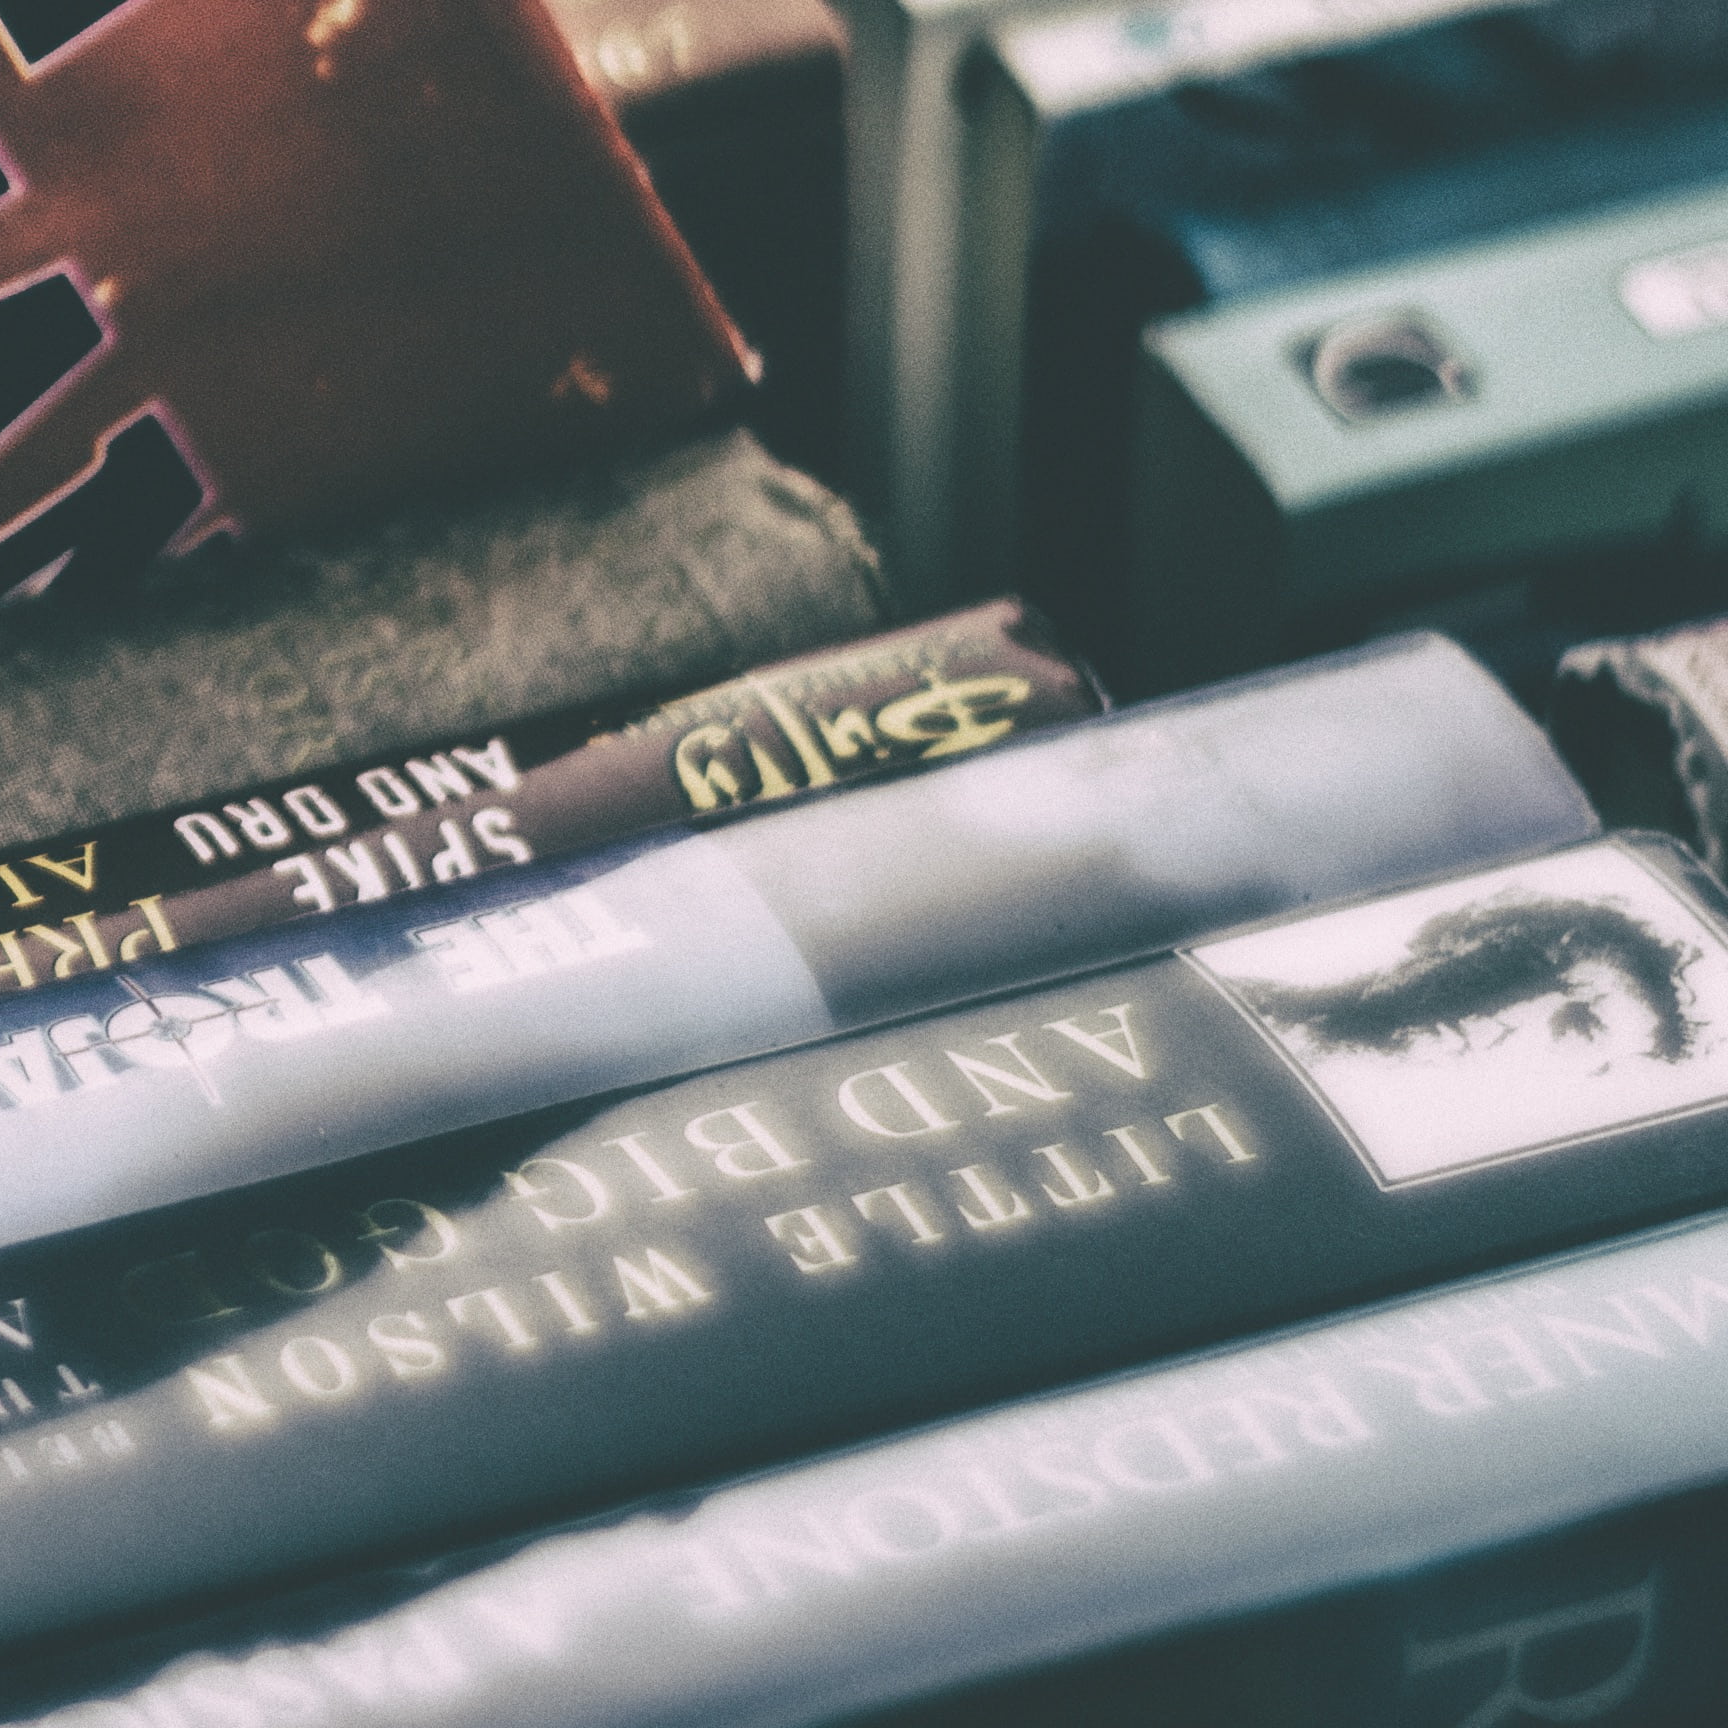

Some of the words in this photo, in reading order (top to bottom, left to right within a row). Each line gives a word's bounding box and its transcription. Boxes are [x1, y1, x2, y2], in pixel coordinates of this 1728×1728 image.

[174, 785, 347, 865] DRU
[356, 737, 524, 812] AND
[273, 806, 534, 913] SPIKE
[402, 889, 656, 996] THE
[837, 1003, 1160, 1140] AND
[504, 1100, 812, 1230] BIG
[762, 1101, 1260, 1277] LITTLE
[185, 1244, 715, 1432] WILSON
[668, 1382, 1377, 1624] REDSTONE
